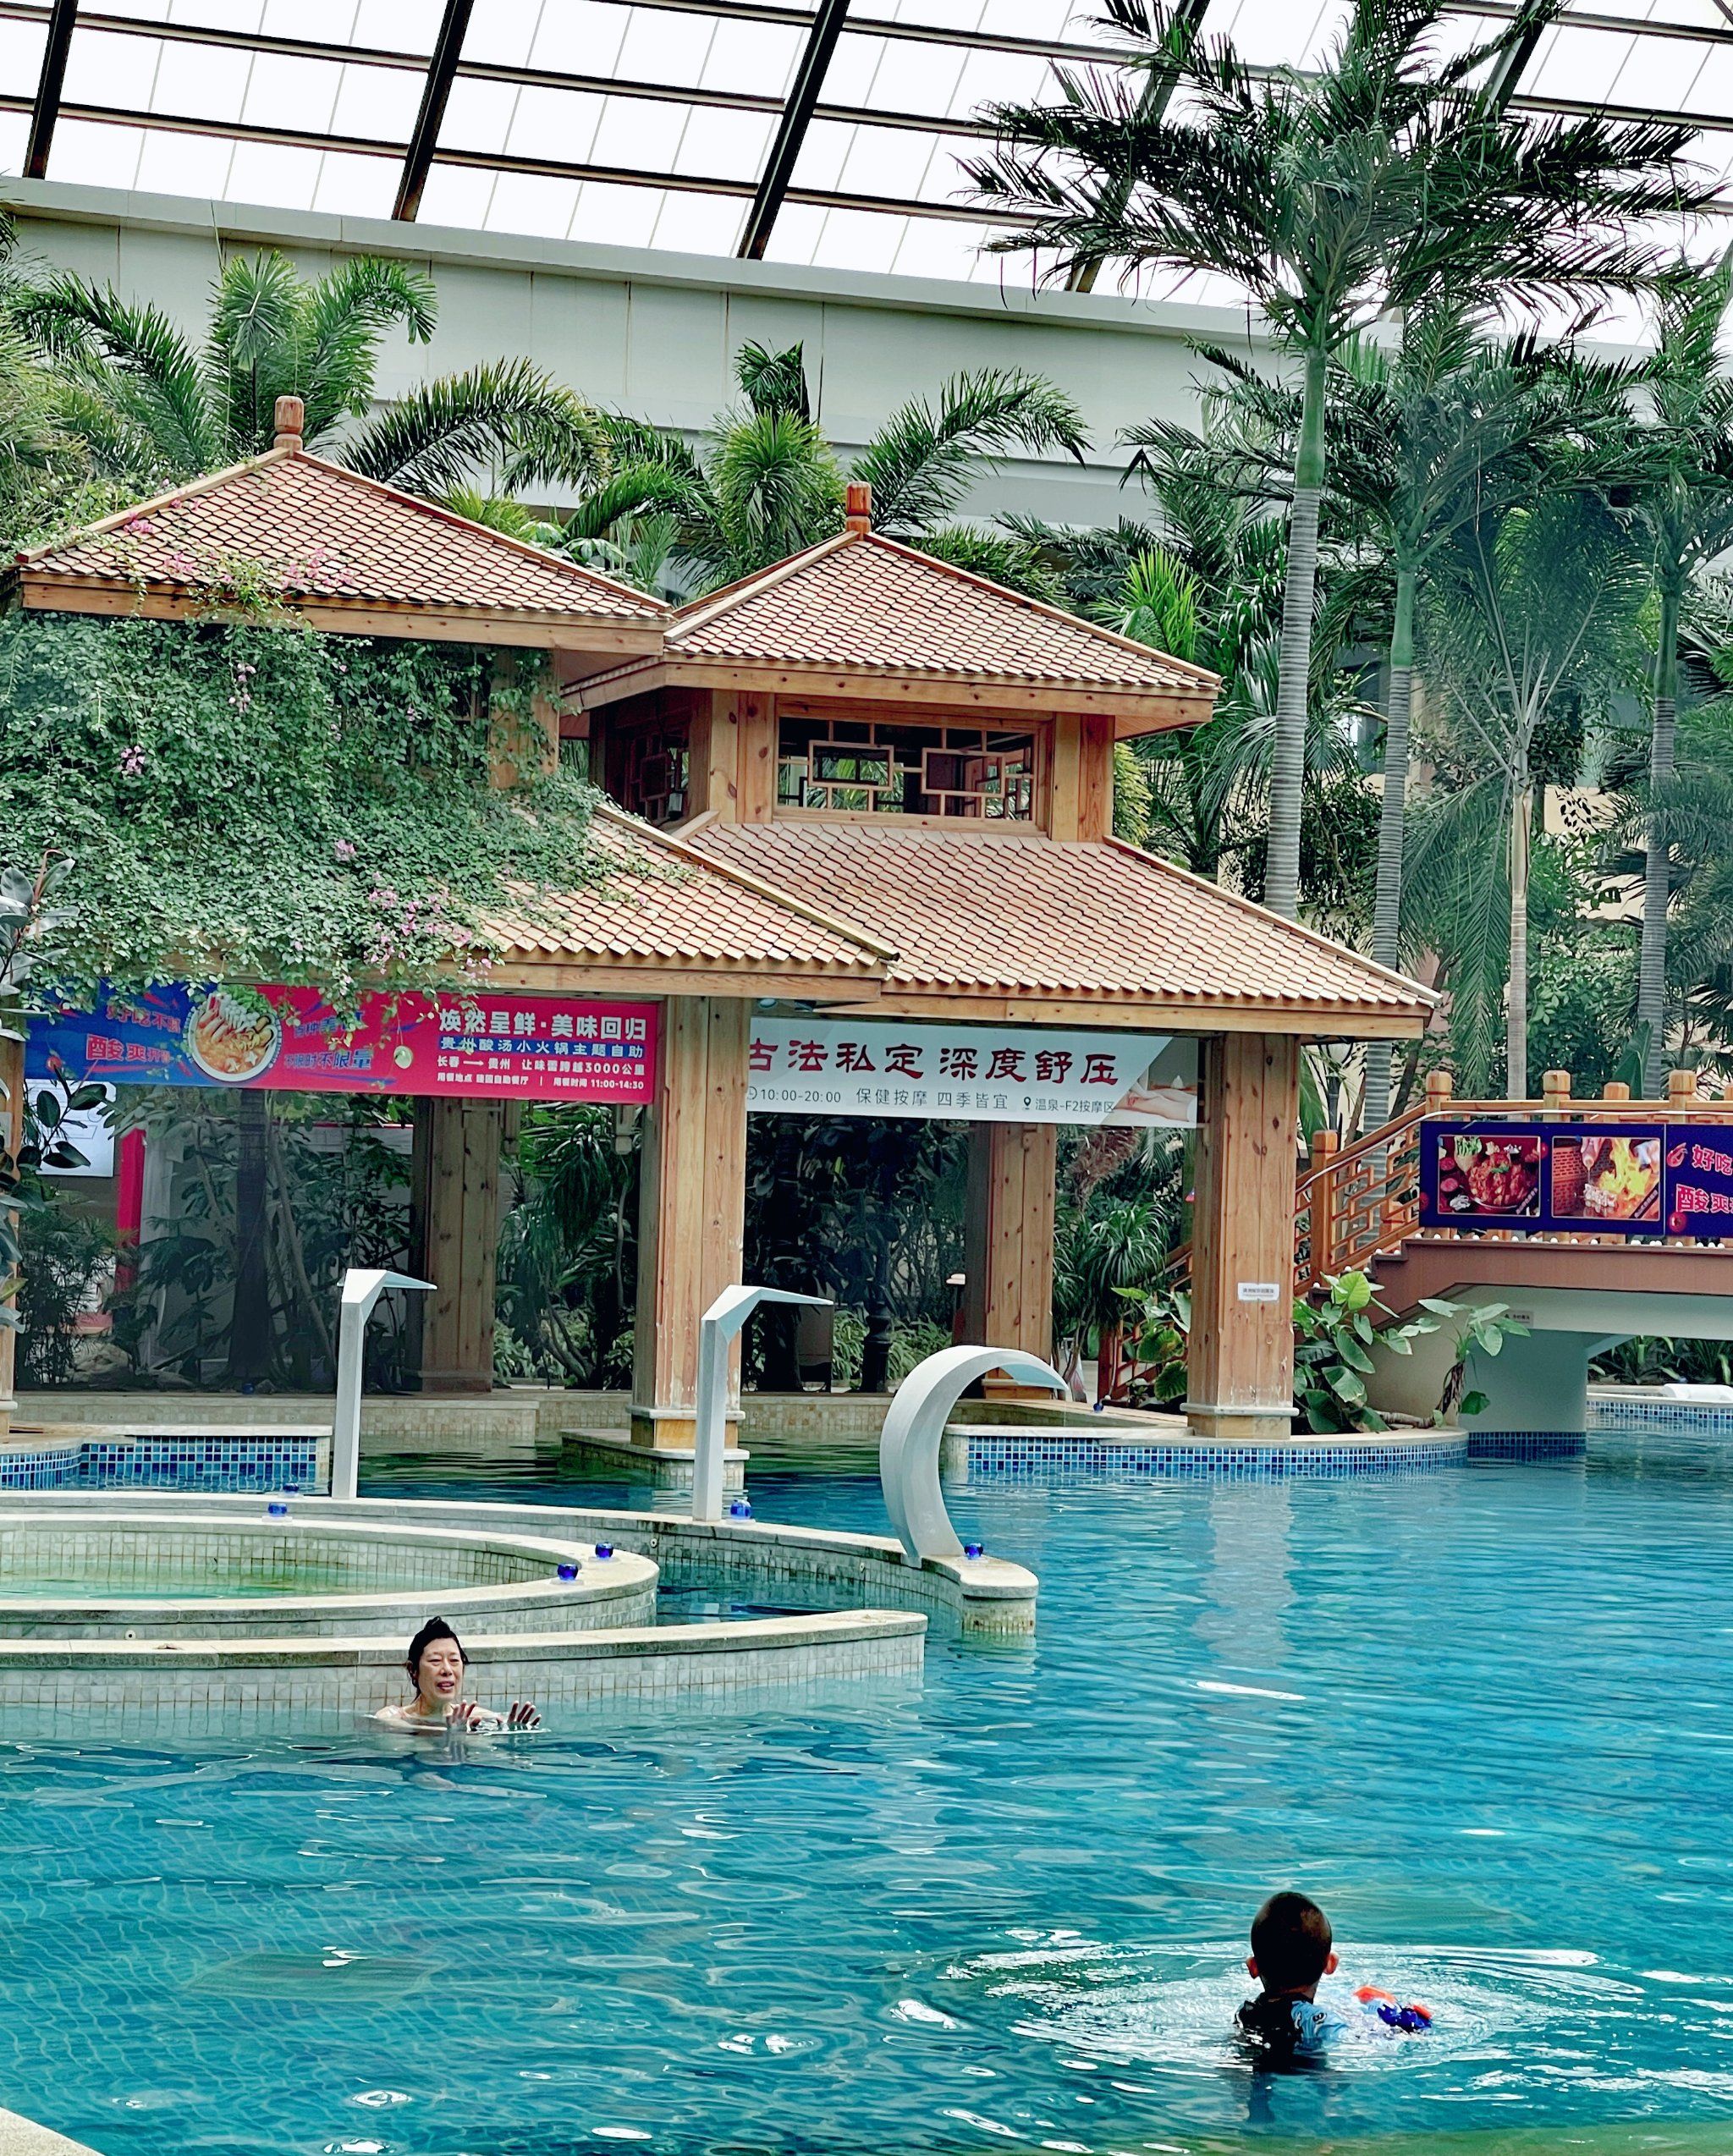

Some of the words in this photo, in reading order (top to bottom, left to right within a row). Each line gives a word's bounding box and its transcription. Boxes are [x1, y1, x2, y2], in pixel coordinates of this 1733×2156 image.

[440, 1037, 643, 1058] 贵州酸汤小火锅主题自助
[487, 1058, 510, 1070] 贵州
[521, 1059, 645, 1075] 让味蕾跨越3000公里
[590, 1079, 644, 1090] 11:00-14:30
[762, 1088, 841, 1103] 10:00-20:00
[855, 1087, 927, 1106] 保健按摩
[937, 1092, 1008, 1110] 四季皆宜
[1035, 1097, 1114, 1114] 温泉-F2按摩区
[1676, 1183, 1733, 1213] 酸爽
